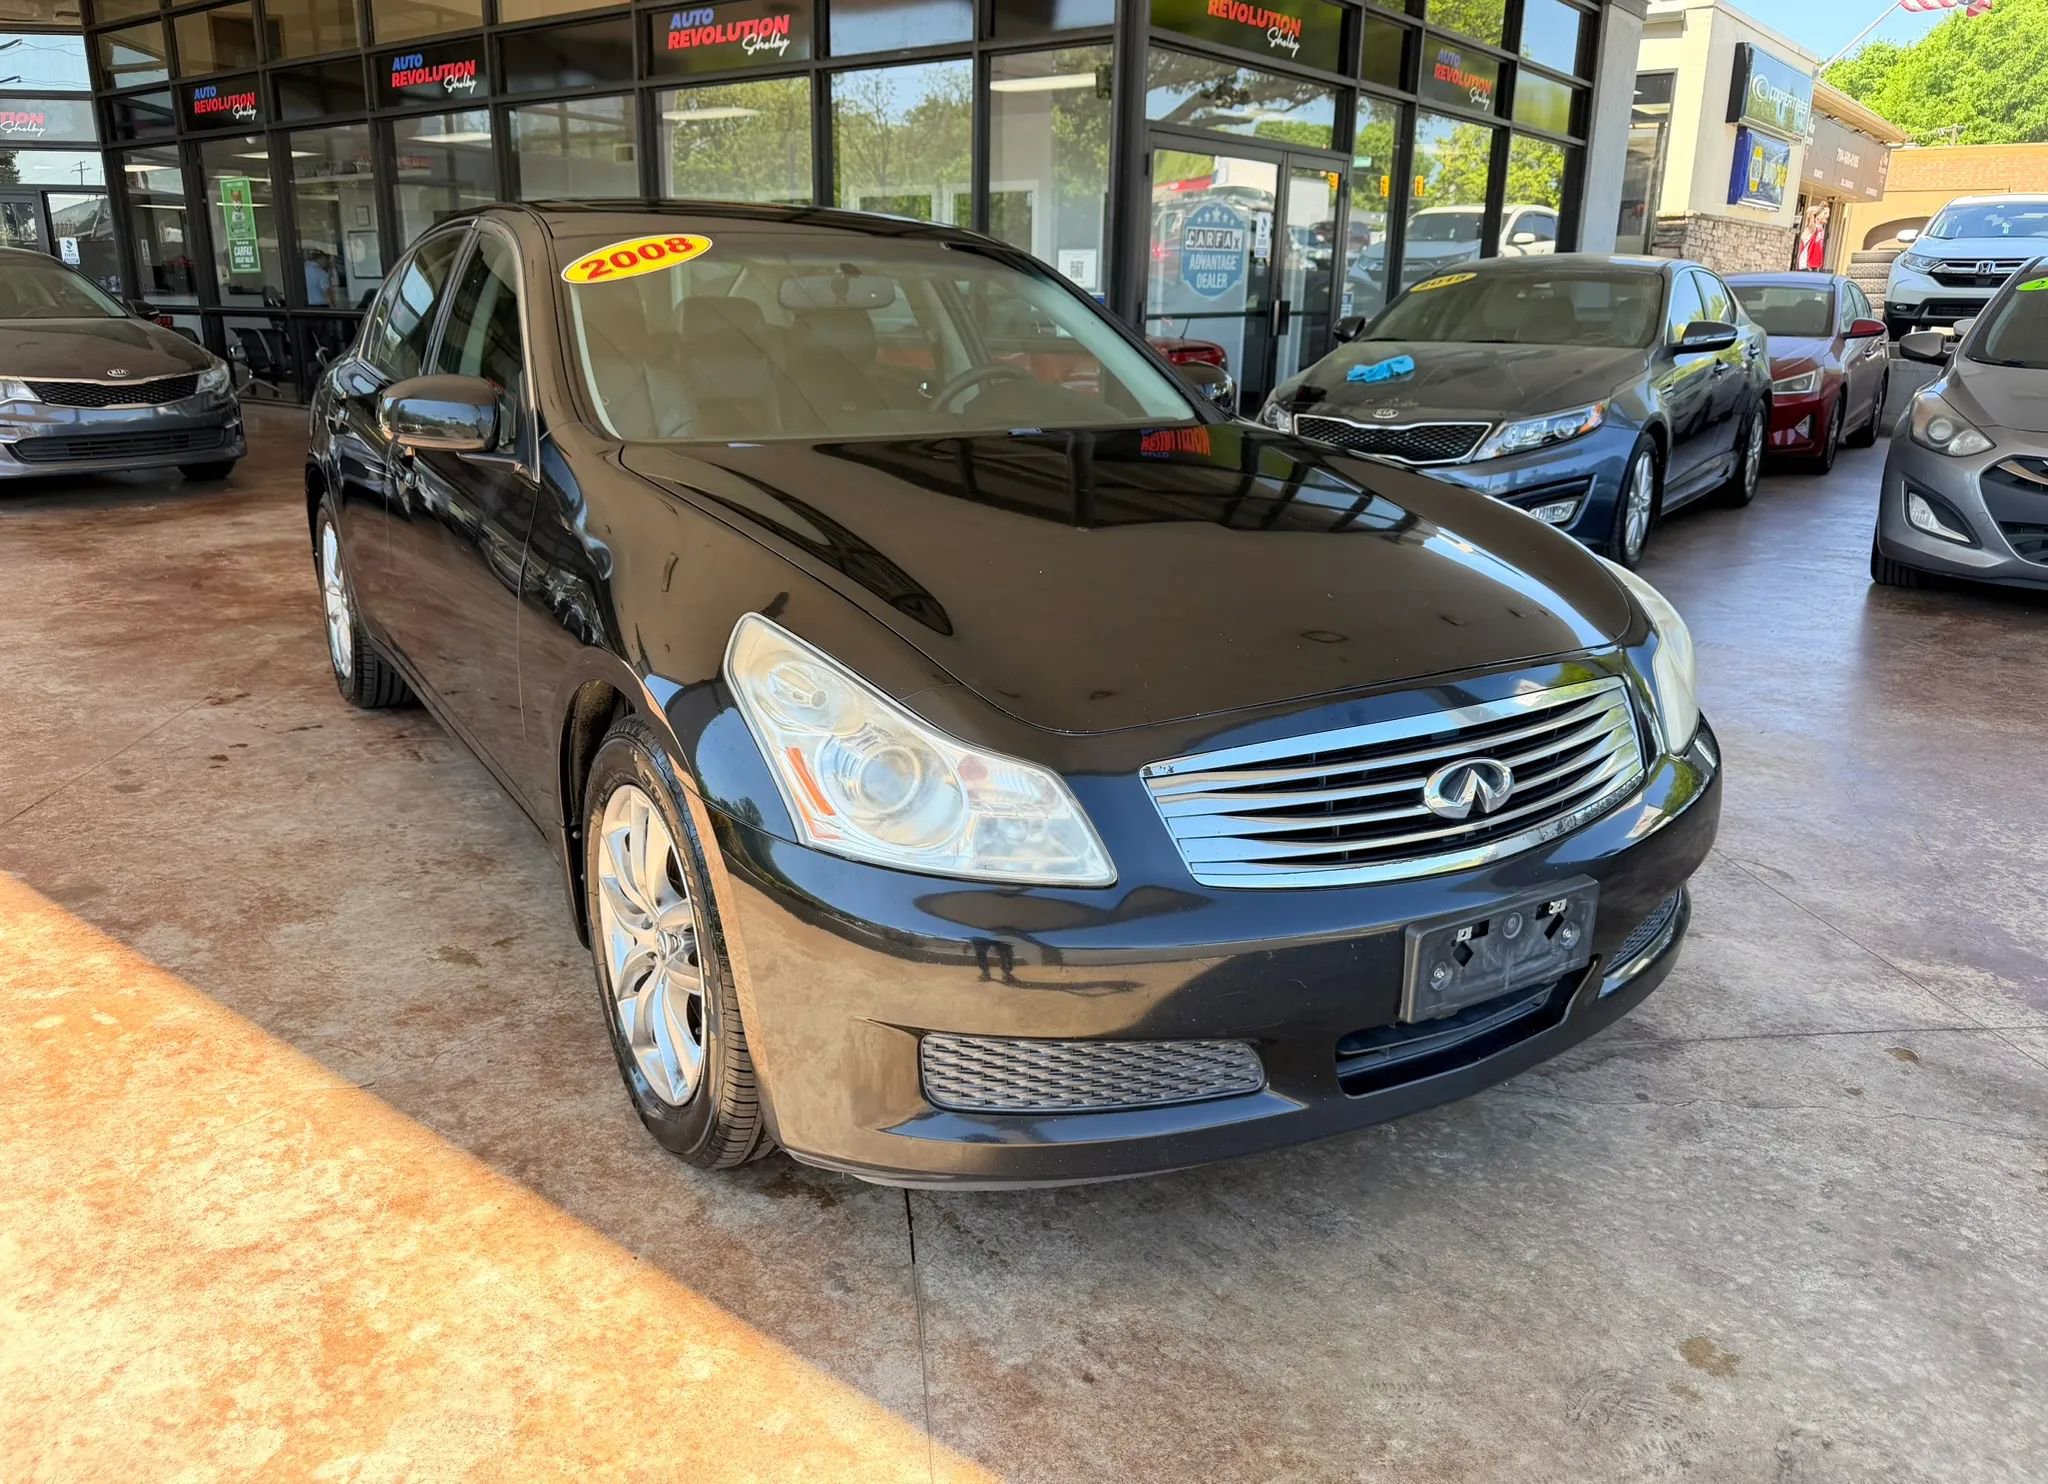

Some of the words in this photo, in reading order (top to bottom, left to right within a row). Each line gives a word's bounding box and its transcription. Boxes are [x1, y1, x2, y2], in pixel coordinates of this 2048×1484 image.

[670, 8, 714, 29] AUTO
[1207, 0, 1301, 37] REVOLUTION
[668, 15, 790, 49] REVOLUTION
[742, 30, 790, 56] Shelby
[1267, 26, 1300, 58] Shelby
[392, 53, 423, 71] AUTO
[1437, 49, 1460, 67] AUTO
[392, 60, 476, 88] REVOLUTION
[443, 71, 477, 94] Shelby
[1434, 63, 1492, 95] REVOLUTION
[194, 86, 217, 100] AUTO
[194, 92, 256, 114] REVOLUTION
[0, 120, 46, 137] Shelby
[1186, 229, 1241, 250] CARFAX
[580, 237, 695, 281] 2008
[1189, 254, 1237, 271] ADVANTAGE
[1196, 272, 1228, 289] DEALER
